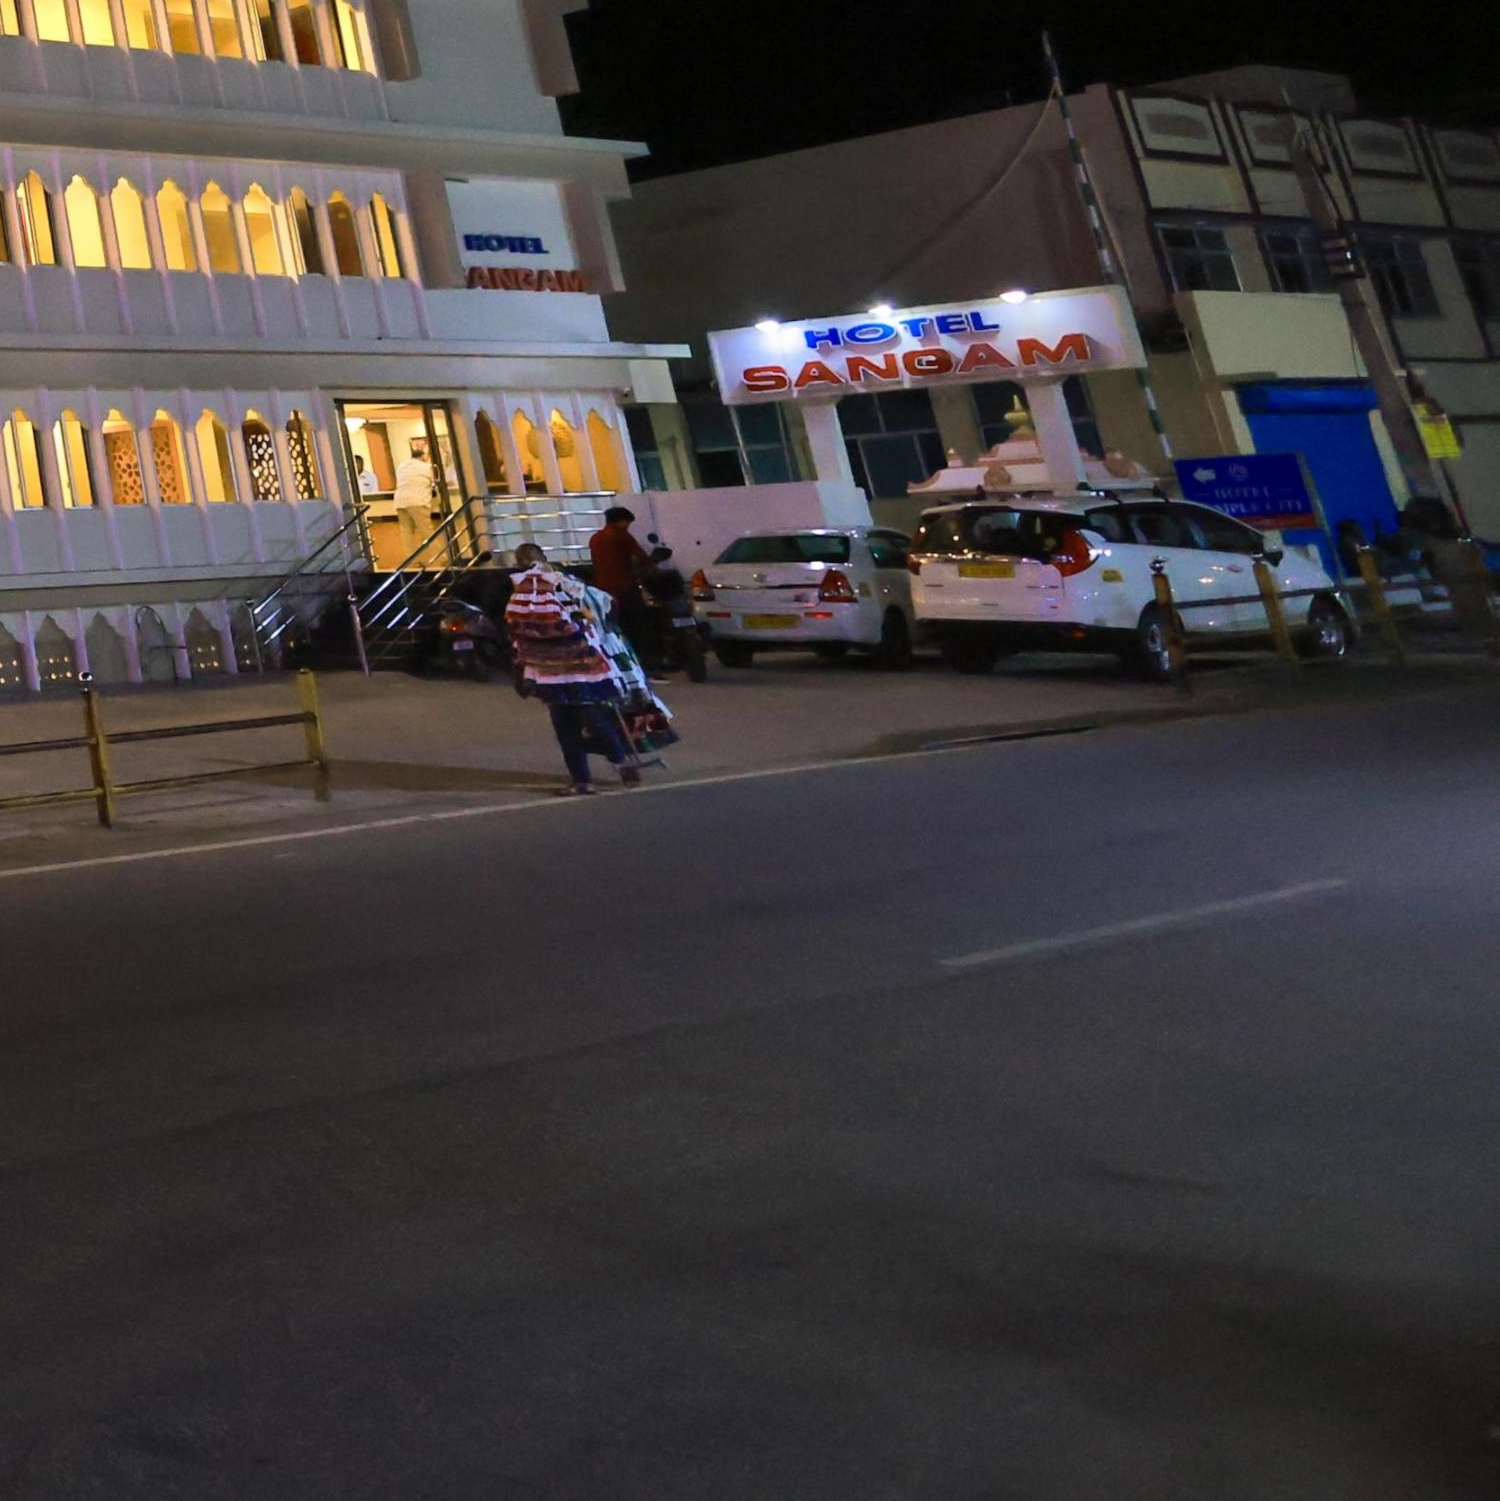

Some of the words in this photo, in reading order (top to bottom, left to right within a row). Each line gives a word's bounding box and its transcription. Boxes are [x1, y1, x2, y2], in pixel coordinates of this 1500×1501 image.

[463, 234, 550, 254] HOTEL
[466, 266, 593, 292] ANGAM
[803, 310, 1001, 350] HOTEL
[741, 333, 1093, 394] SANGAM
